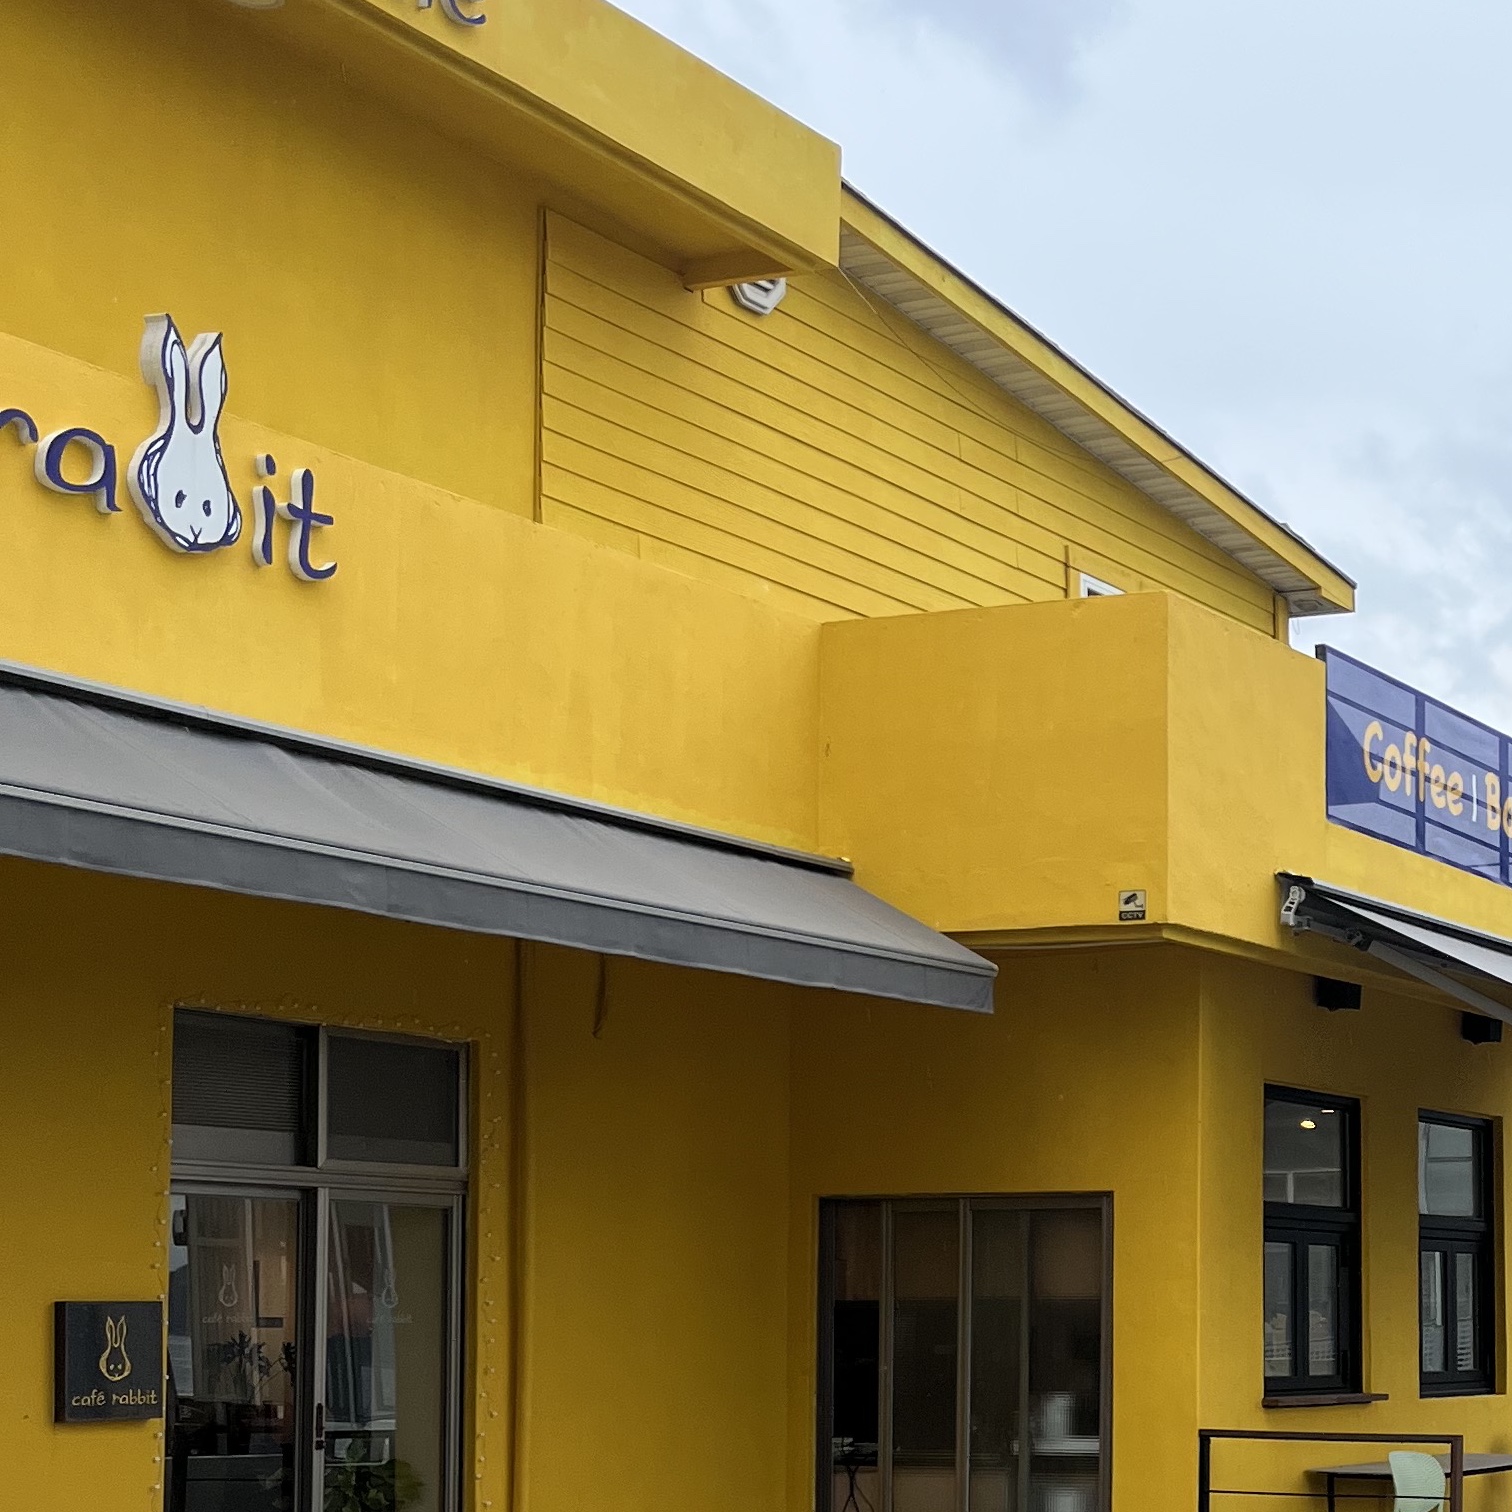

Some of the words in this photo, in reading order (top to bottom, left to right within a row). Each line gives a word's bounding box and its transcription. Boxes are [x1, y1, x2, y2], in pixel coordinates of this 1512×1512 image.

[1363, 721, 1464, 817] Coffee
[71, 1388, 107, 1407] café
[112, 1388, 158, 1406] rabbit
